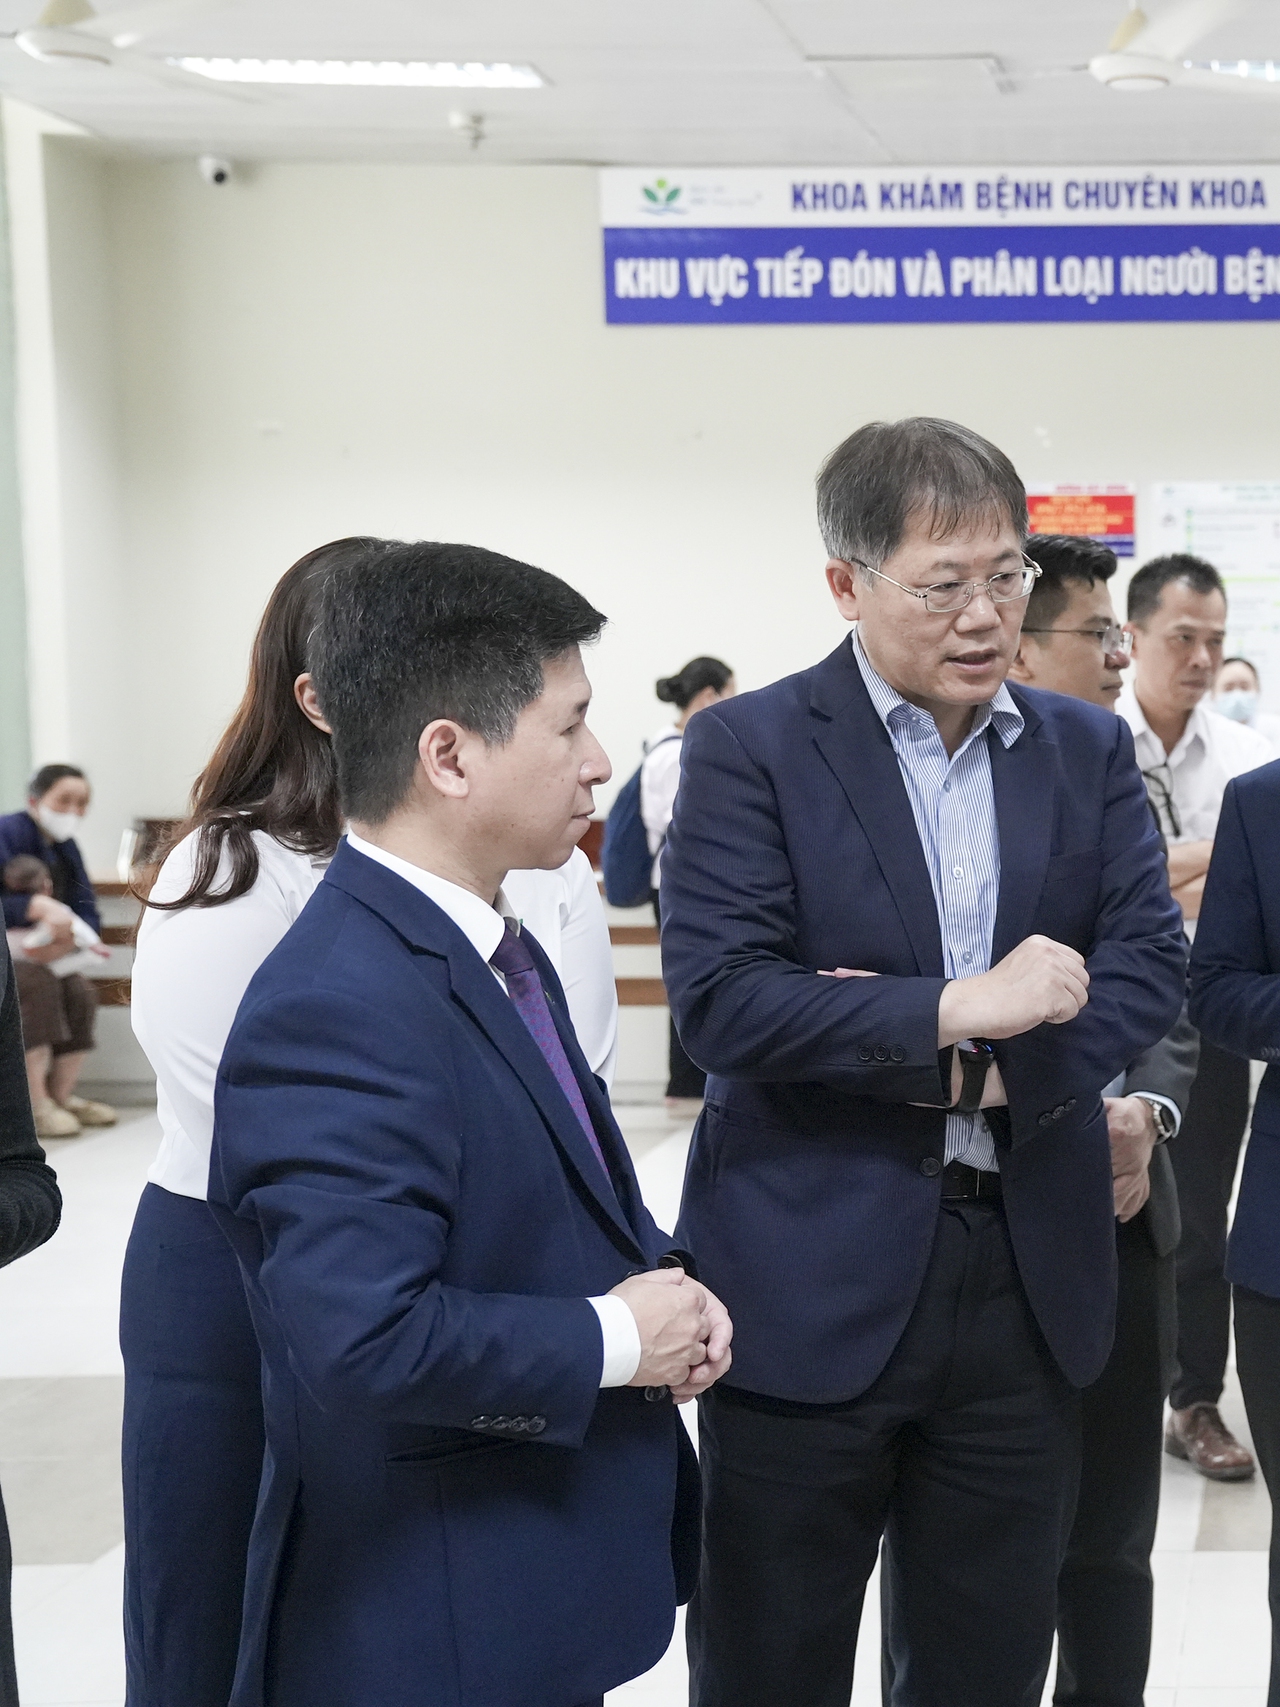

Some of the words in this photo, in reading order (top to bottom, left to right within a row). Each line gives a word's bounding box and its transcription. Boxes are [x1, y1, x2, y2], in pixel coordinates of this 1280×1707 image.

[791, 183, 868, 211] KHOA
[880, 176, 964, 211] KHÁM
[975, 174, 1053, 217] BỆNH
[1063, 172, 1178, 211] CHUYÊN
[1189, 179, 1267, 209] KHOA
[614, 256, 680, 299] KHU
[685, 254, 749, 306] VỰC
[754, 247, 824, 298] TIẾP
[829, 250, 897, 298] ĐÓN
[902, 250, 946, 298] VÀ
[950, 250, 1038, 297] PHÂN
[1043, 255, 1115, 304] LOẠI
[1121, 247, 1218, 296] NGƯỜI
